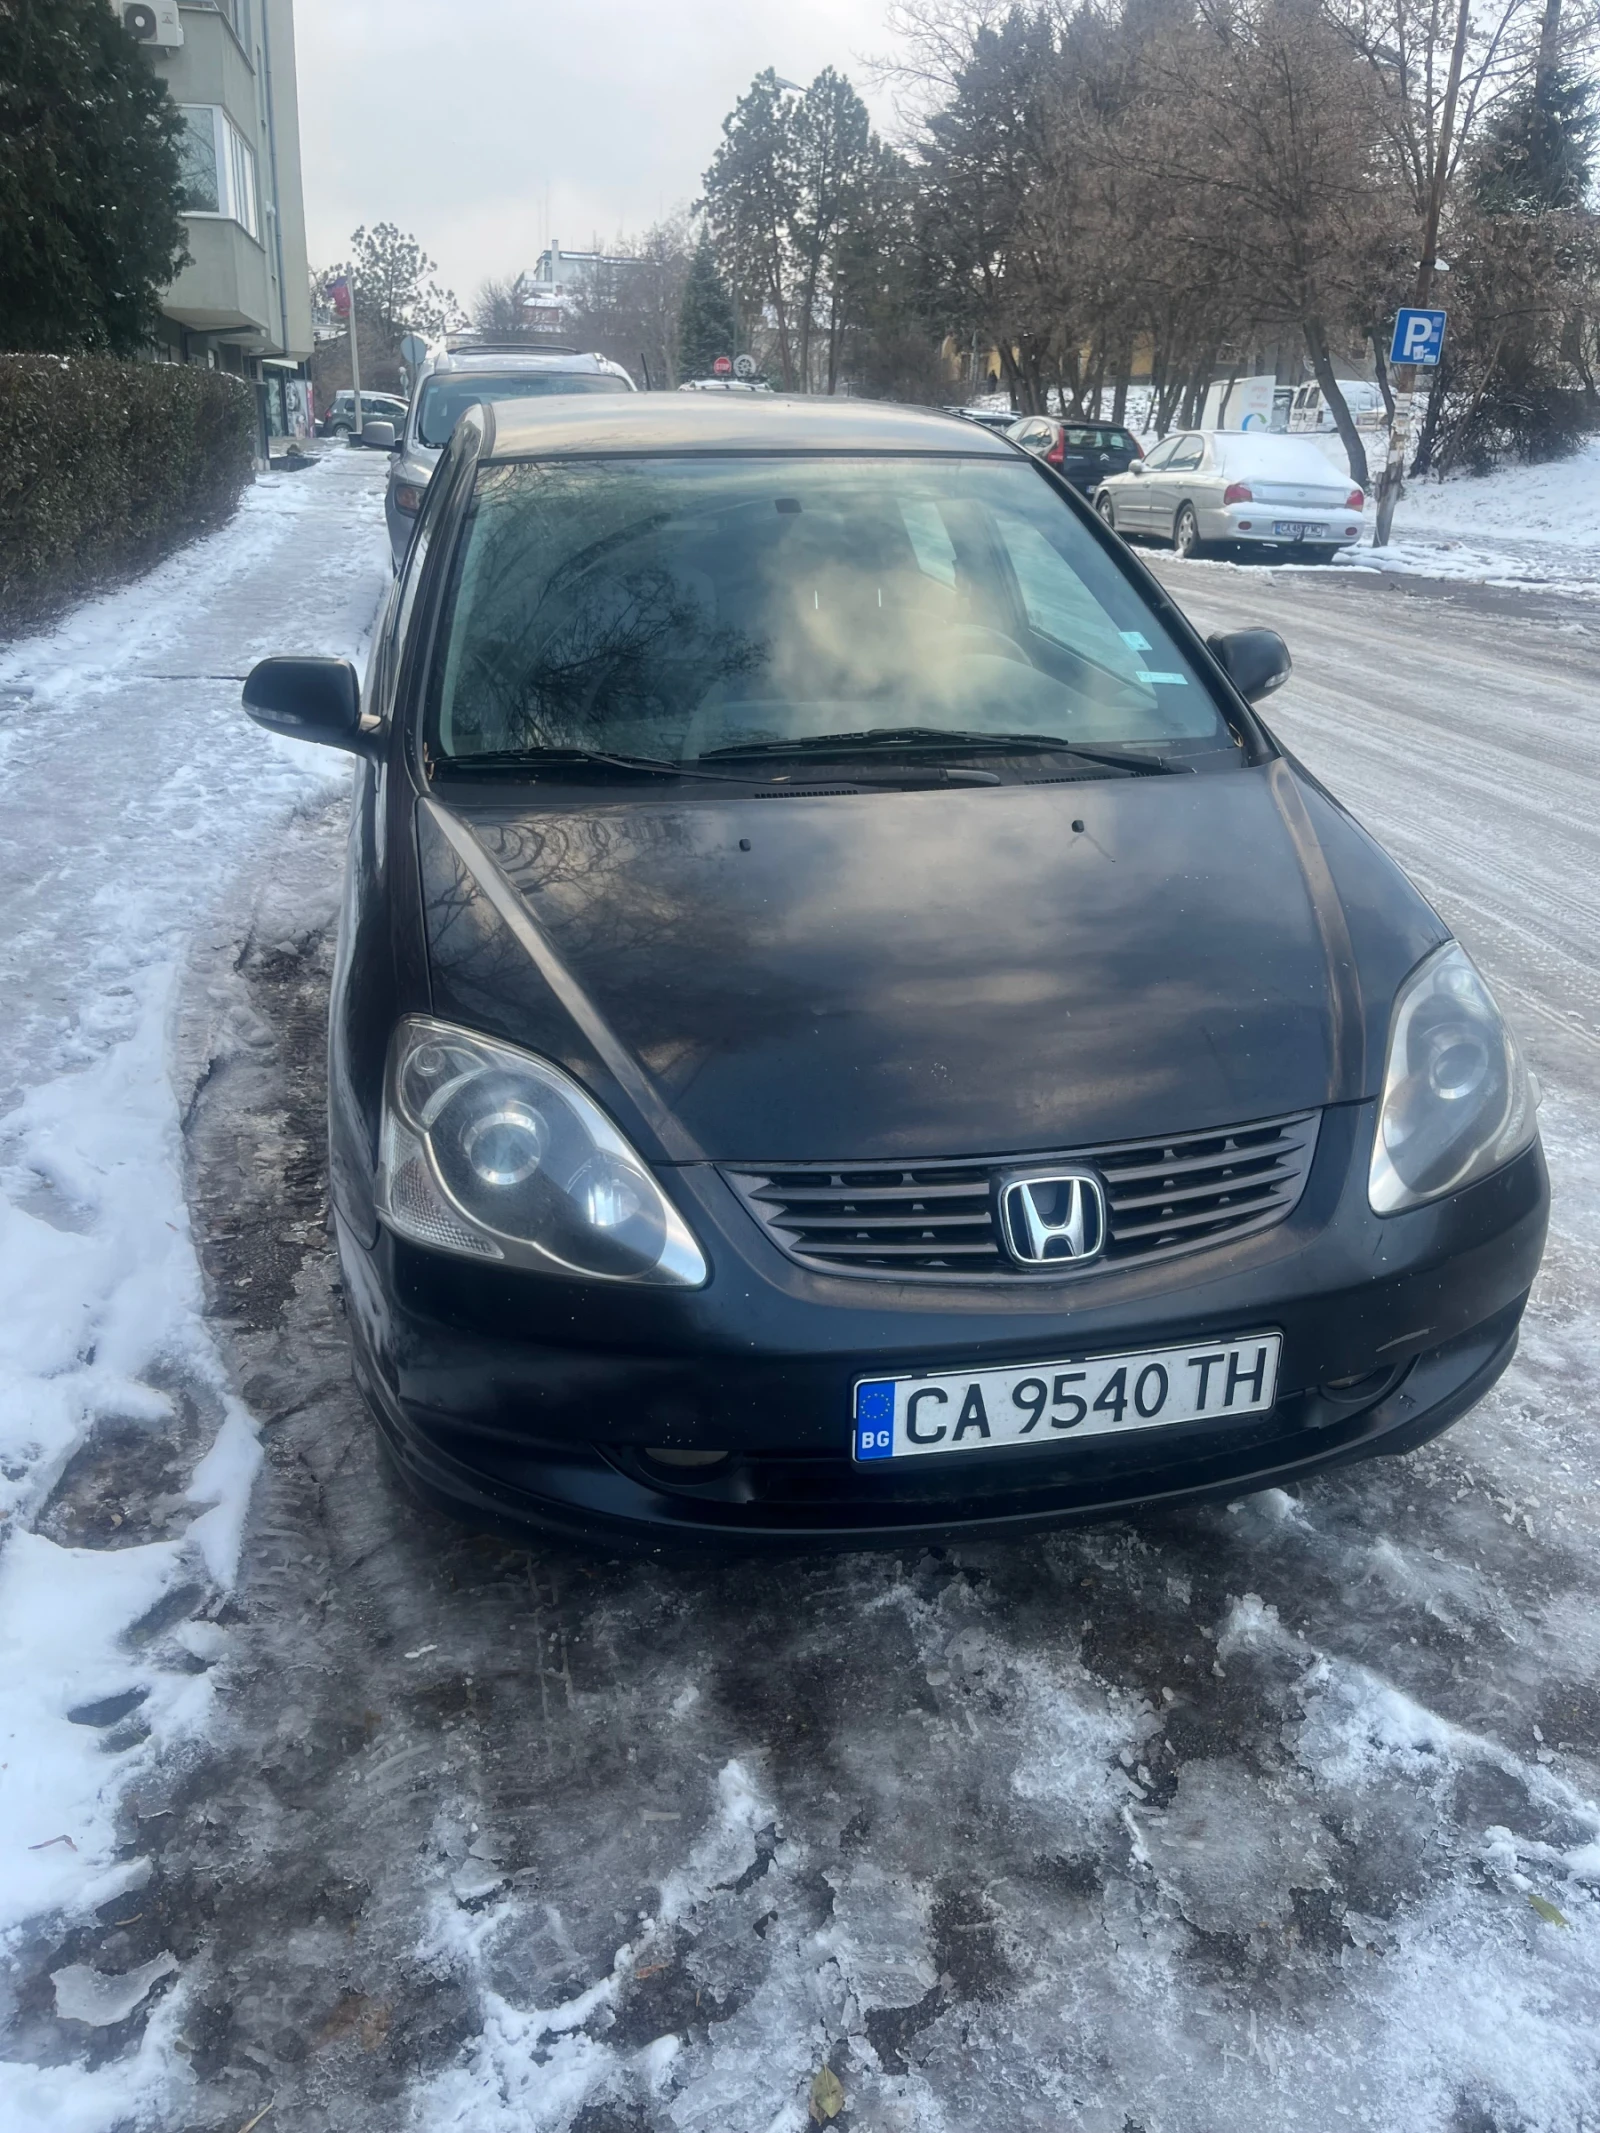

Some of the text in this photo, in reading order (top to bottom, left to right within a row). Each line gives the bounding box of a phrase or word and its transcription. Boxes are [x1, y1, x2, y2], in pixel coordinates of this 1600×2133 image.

[1403, 316, 1432, 356] P
[715, 363, 730, 371] STOP
[1280, 523, 1291, 532] CA
[1291, 524, 1310, 534] 487
[906, 1347, 1268, 1444] CA 9540 TH
[861, 1430, 890, 1449] BG
